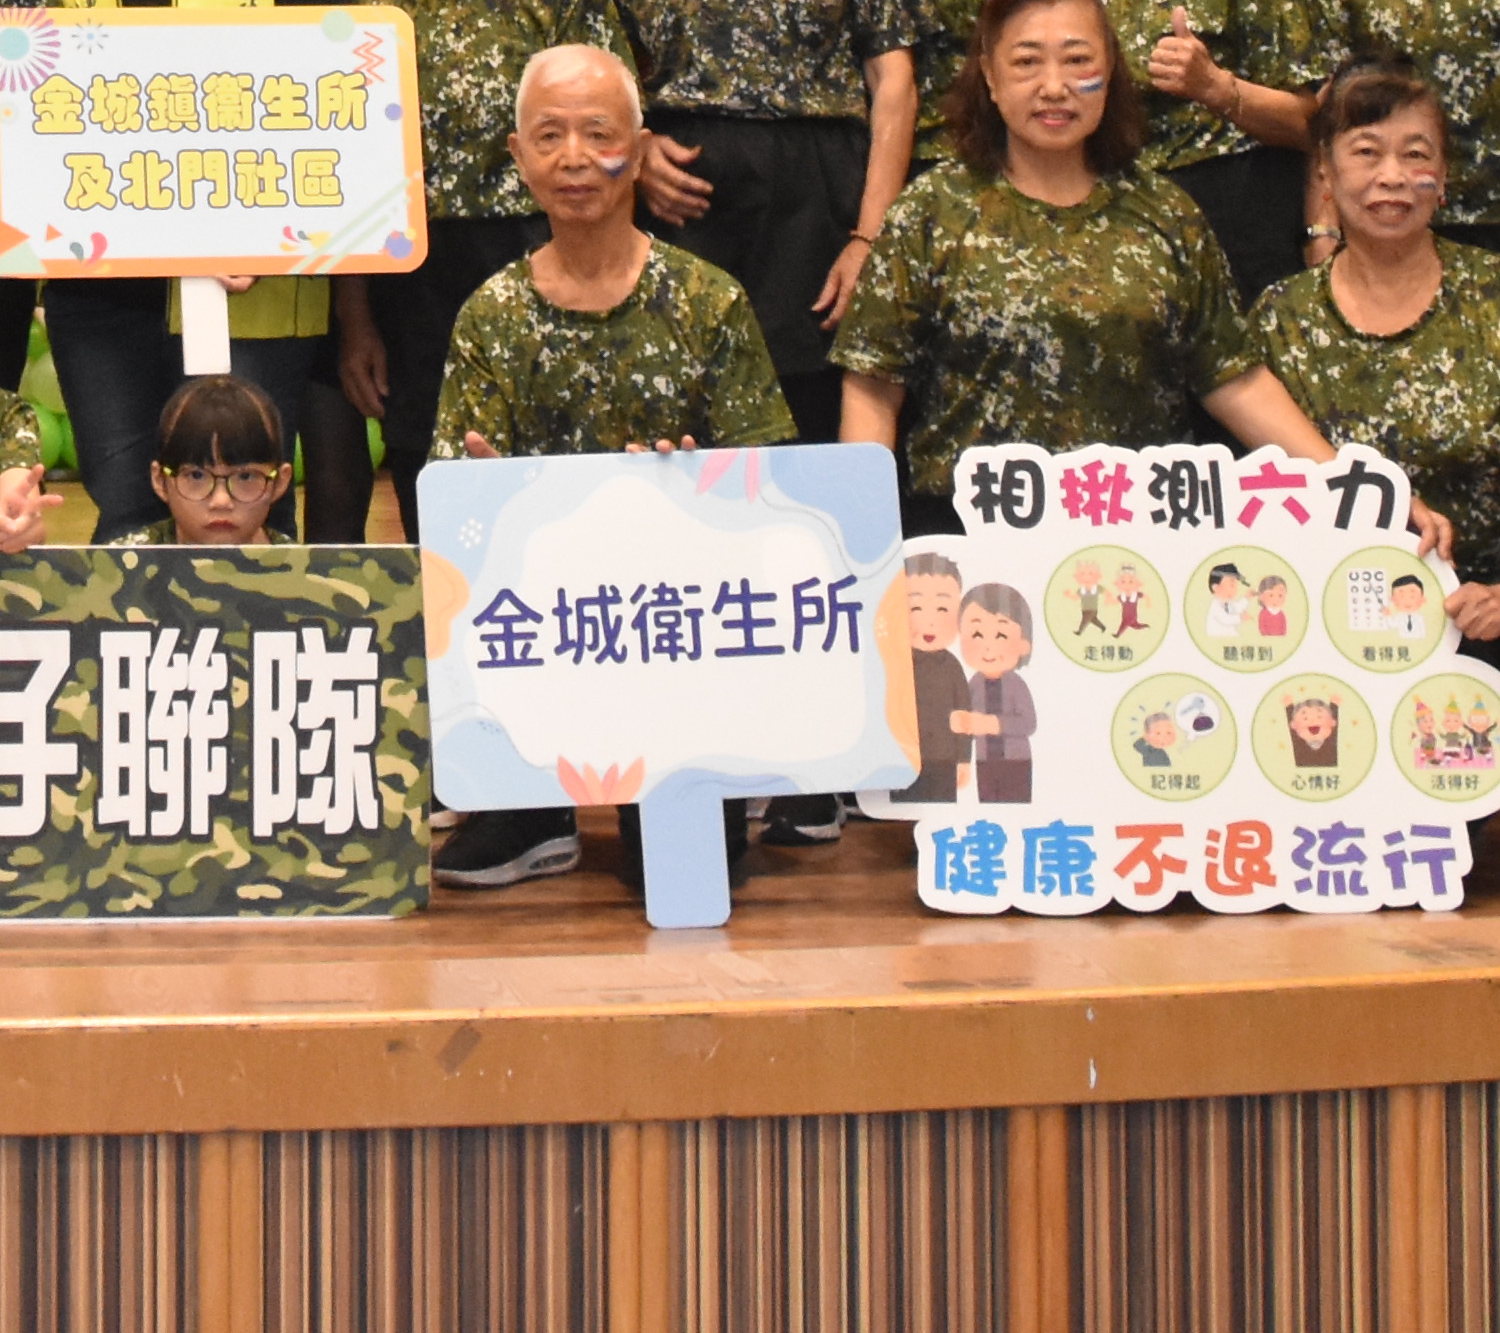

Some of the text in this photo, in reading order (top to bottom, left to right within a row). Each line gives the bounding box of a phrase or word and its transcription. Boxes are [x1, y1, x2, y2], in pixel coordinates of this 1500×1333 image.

[31, 70, 369, 135] 金城鎮衛生所
[62, 148, 345, 211] 及北門社區
[970, 458, 1396, 531] 相揪測六力
[472, 574, 864, 670] 金城衛生所
[1084, 645, 1134, 662] 走得動
[1223, 645, 1274, 662] 聽得到
[1362, 646, 1411, 663] 看得見
[1151, 774, 1201, 791] 記得起
[1291, 774, 1340, 791] 心情好
[1431, 774, 1480, 791] 活得好
[931, 819, 1457, 898] 健康不退流行
